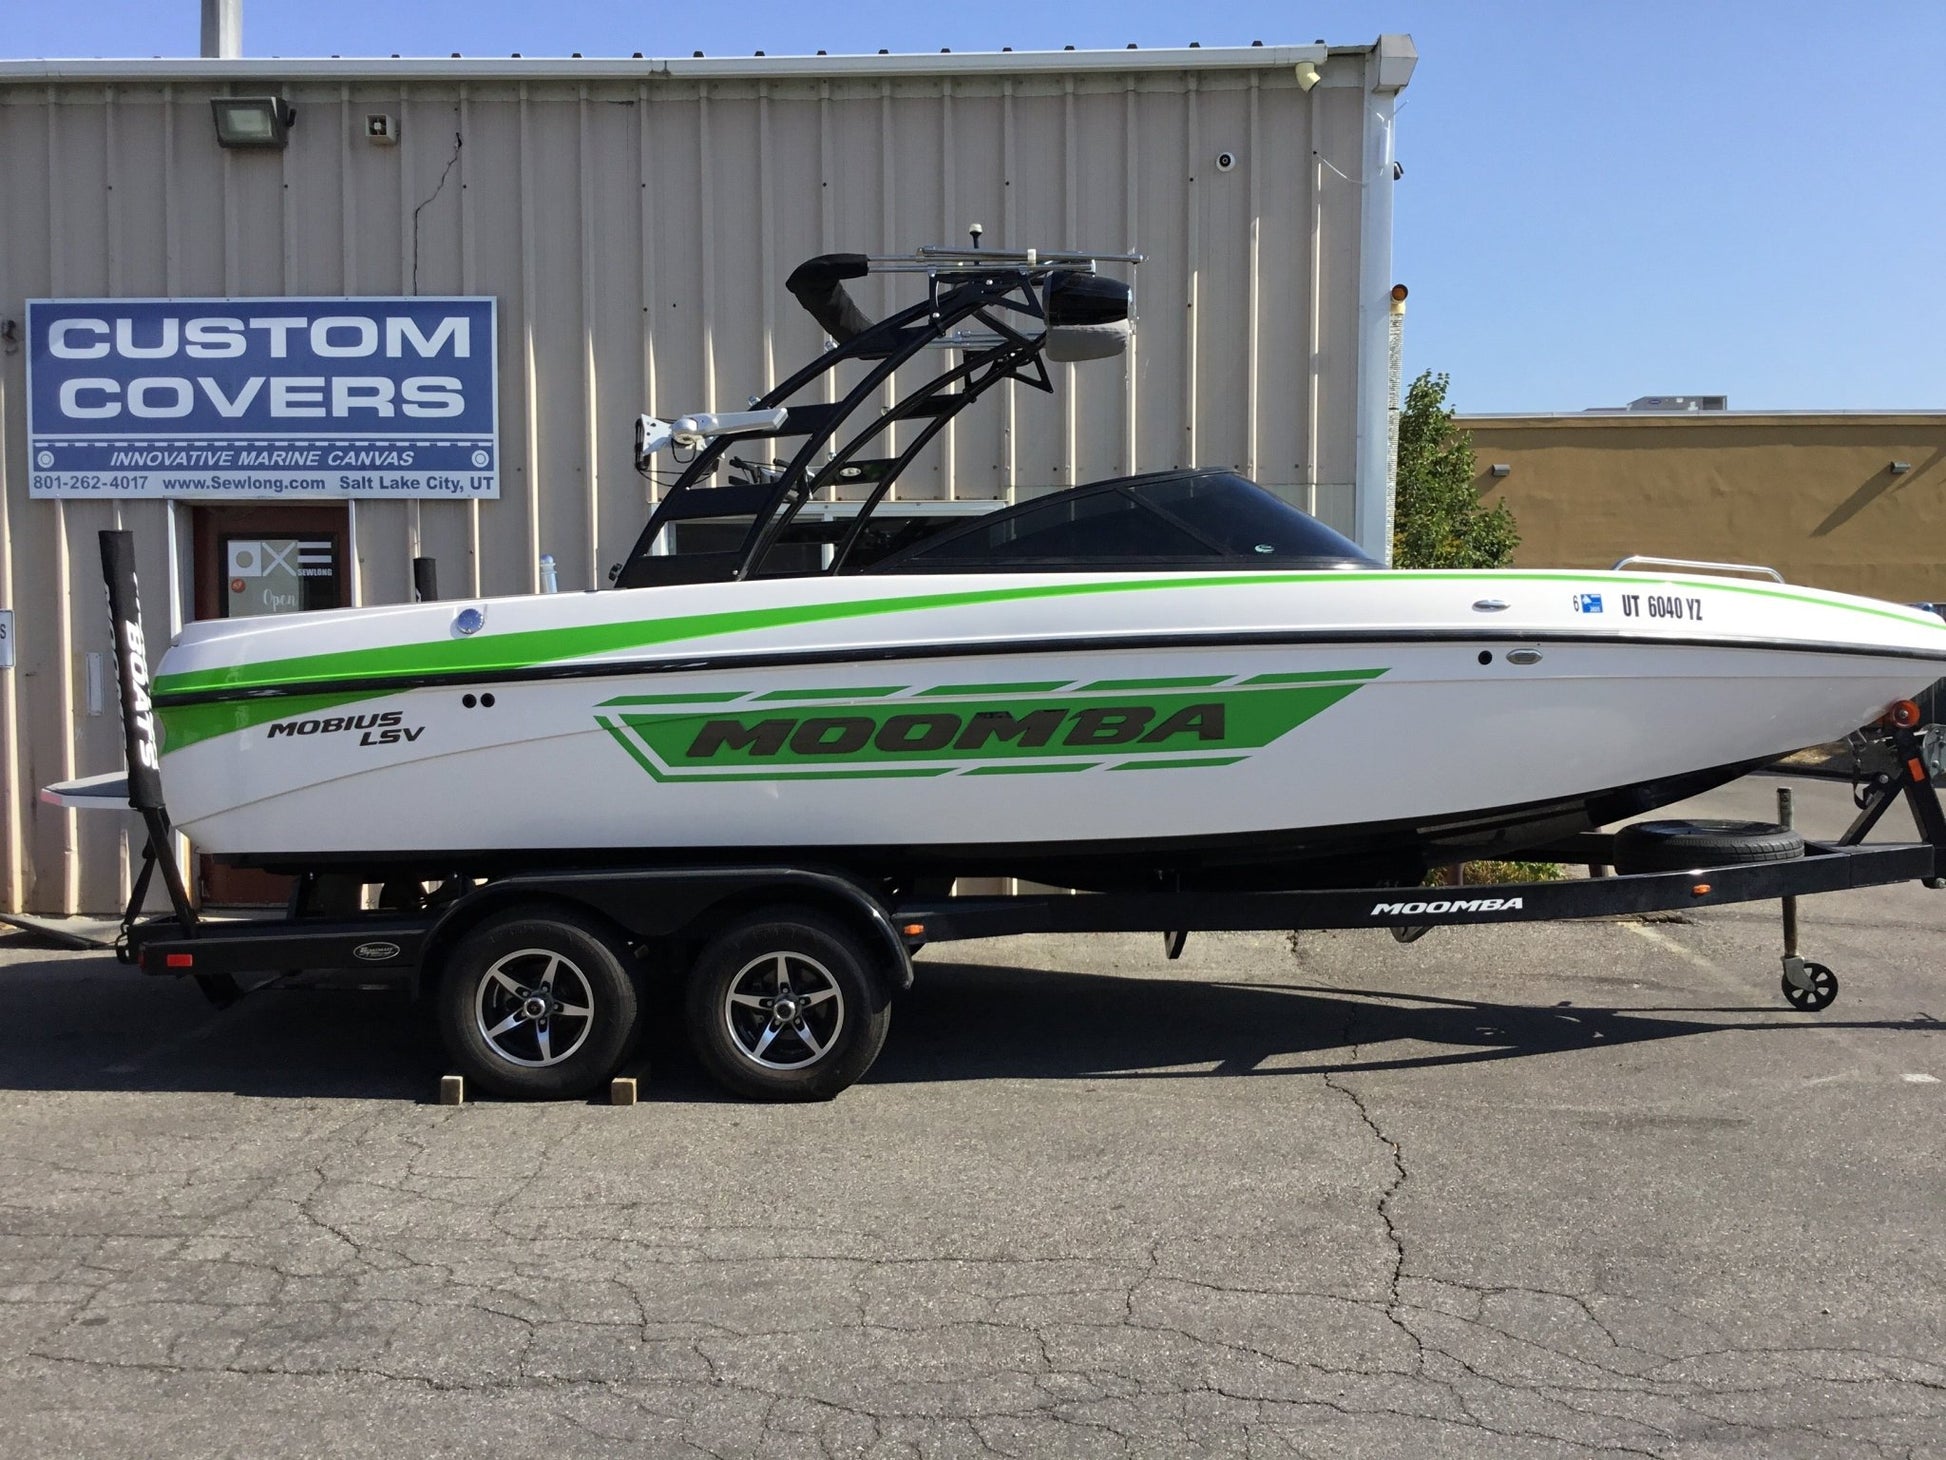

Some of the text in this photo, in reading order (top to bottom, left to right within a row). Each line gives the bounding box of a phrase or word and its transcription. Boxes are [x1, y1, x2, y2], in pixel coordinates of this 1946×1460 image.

[48, 316, 471, 359] CUSTOM
[59, 376, 465, 419] COVERS
[110, 451, 414, 467] INNOVATIVE MARINE CANVAS
[33, 475, 494, 493] 801-262-4017 www.Sewlong.com Salt Lake City, UT
[297, 568, 333, 577] SEWLONG
[263, 588, 296, 612] Open
[1621, 594, 1703, 621] UT 6040 YZ
[126, 620, 159, 770] BOATS
[266, 710, 404, 739] MOBIUS
[359, 726, 426, 747] LSV
[686, 703, 1226, 758] MOOMBA
[1370, 897, 1524, 916] MOOMBA
